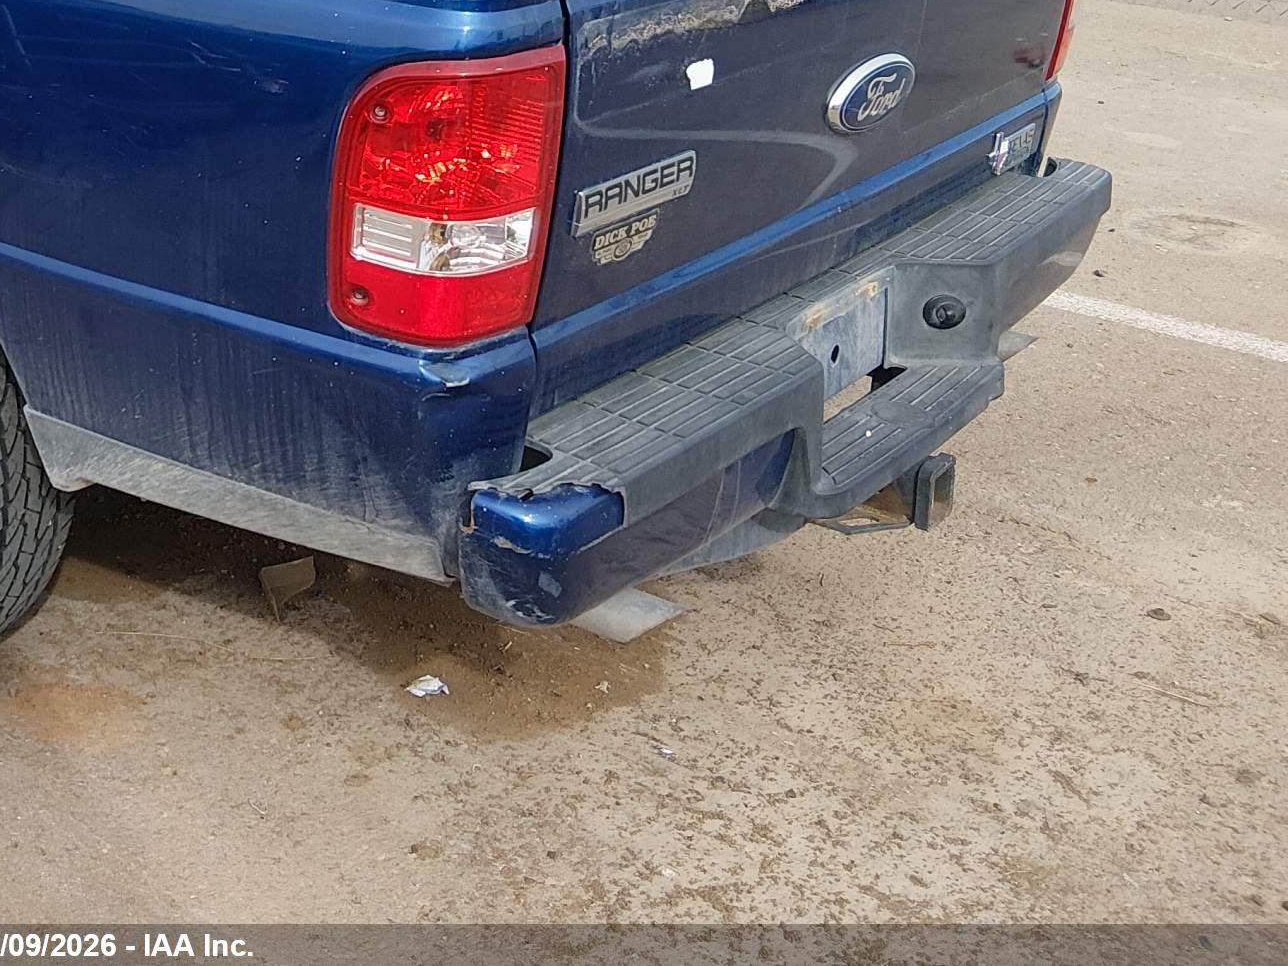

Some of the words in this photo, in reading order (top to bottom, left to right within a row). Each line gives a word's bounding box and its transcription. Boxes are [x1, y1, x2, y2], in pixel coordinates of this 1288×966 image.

[857, 73, 907, 121] Ford
[584, 156, 694, 219] RANGER
[594, 226, 629, 250] DICK
[629, 215, 657, 236] POE
